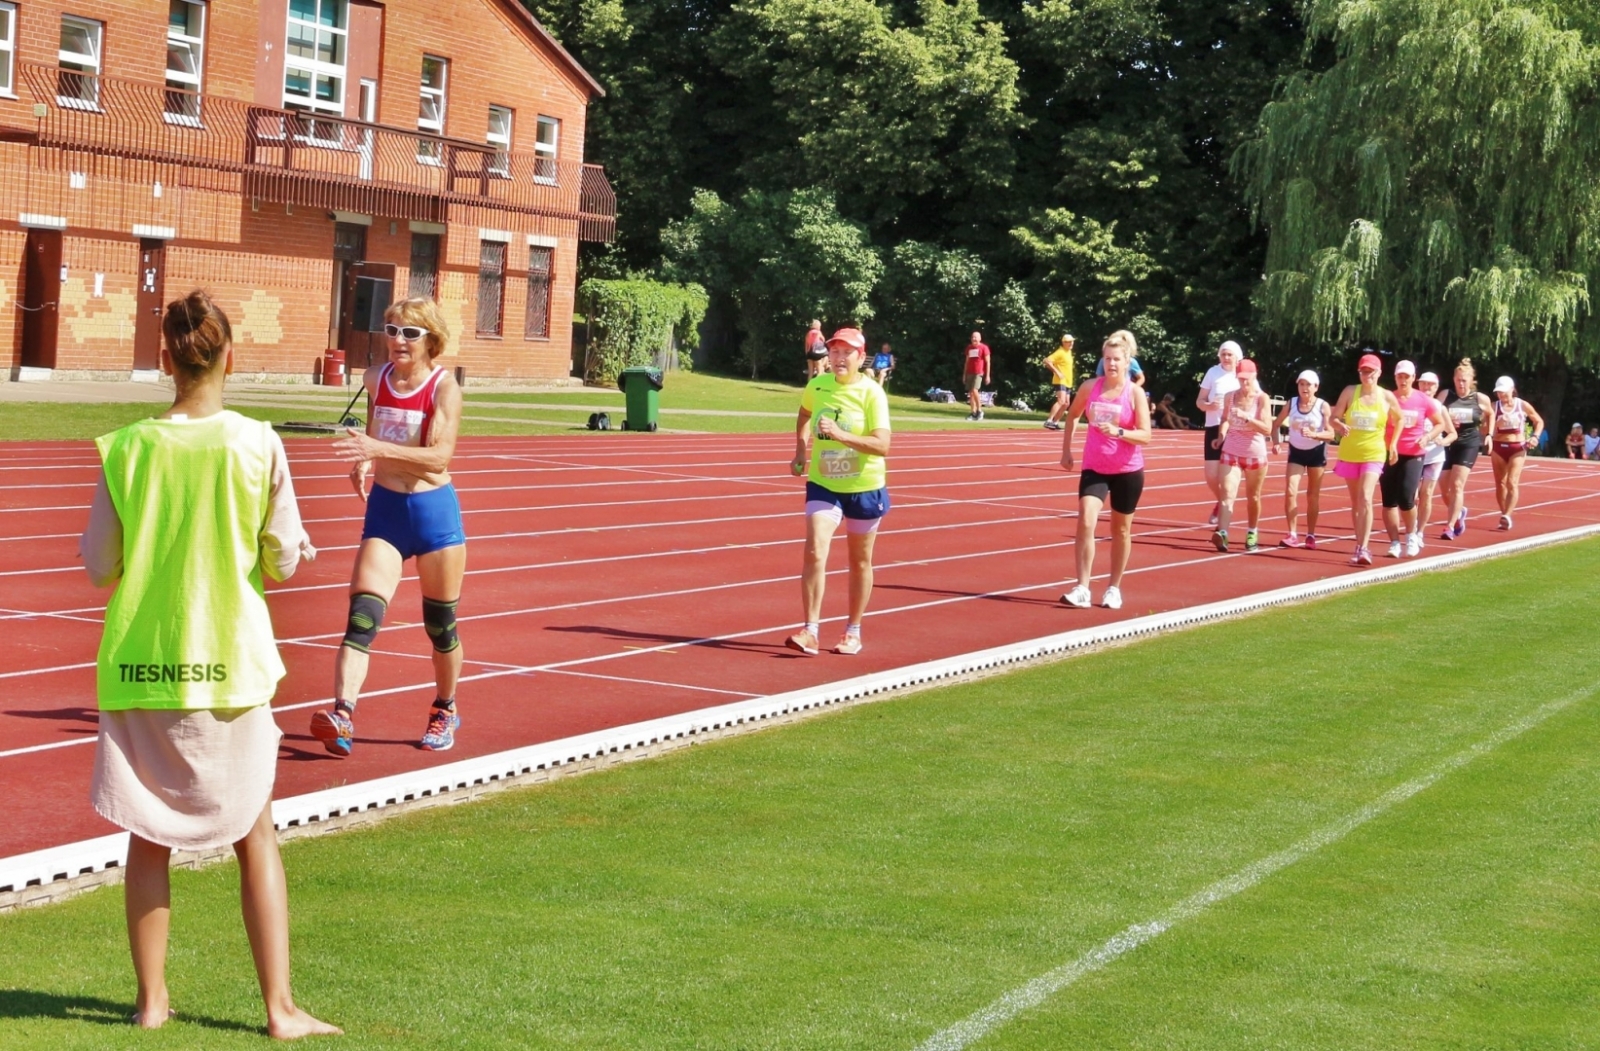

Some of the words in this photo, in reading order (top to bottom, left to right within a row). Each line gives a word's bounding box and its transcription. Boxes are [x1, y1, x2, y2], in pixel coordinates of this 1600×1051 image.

[379, 424, 408, 442] 143
[825, 460, 851, 472] 120
[119, 663, 227, 682] TIESNESIS
